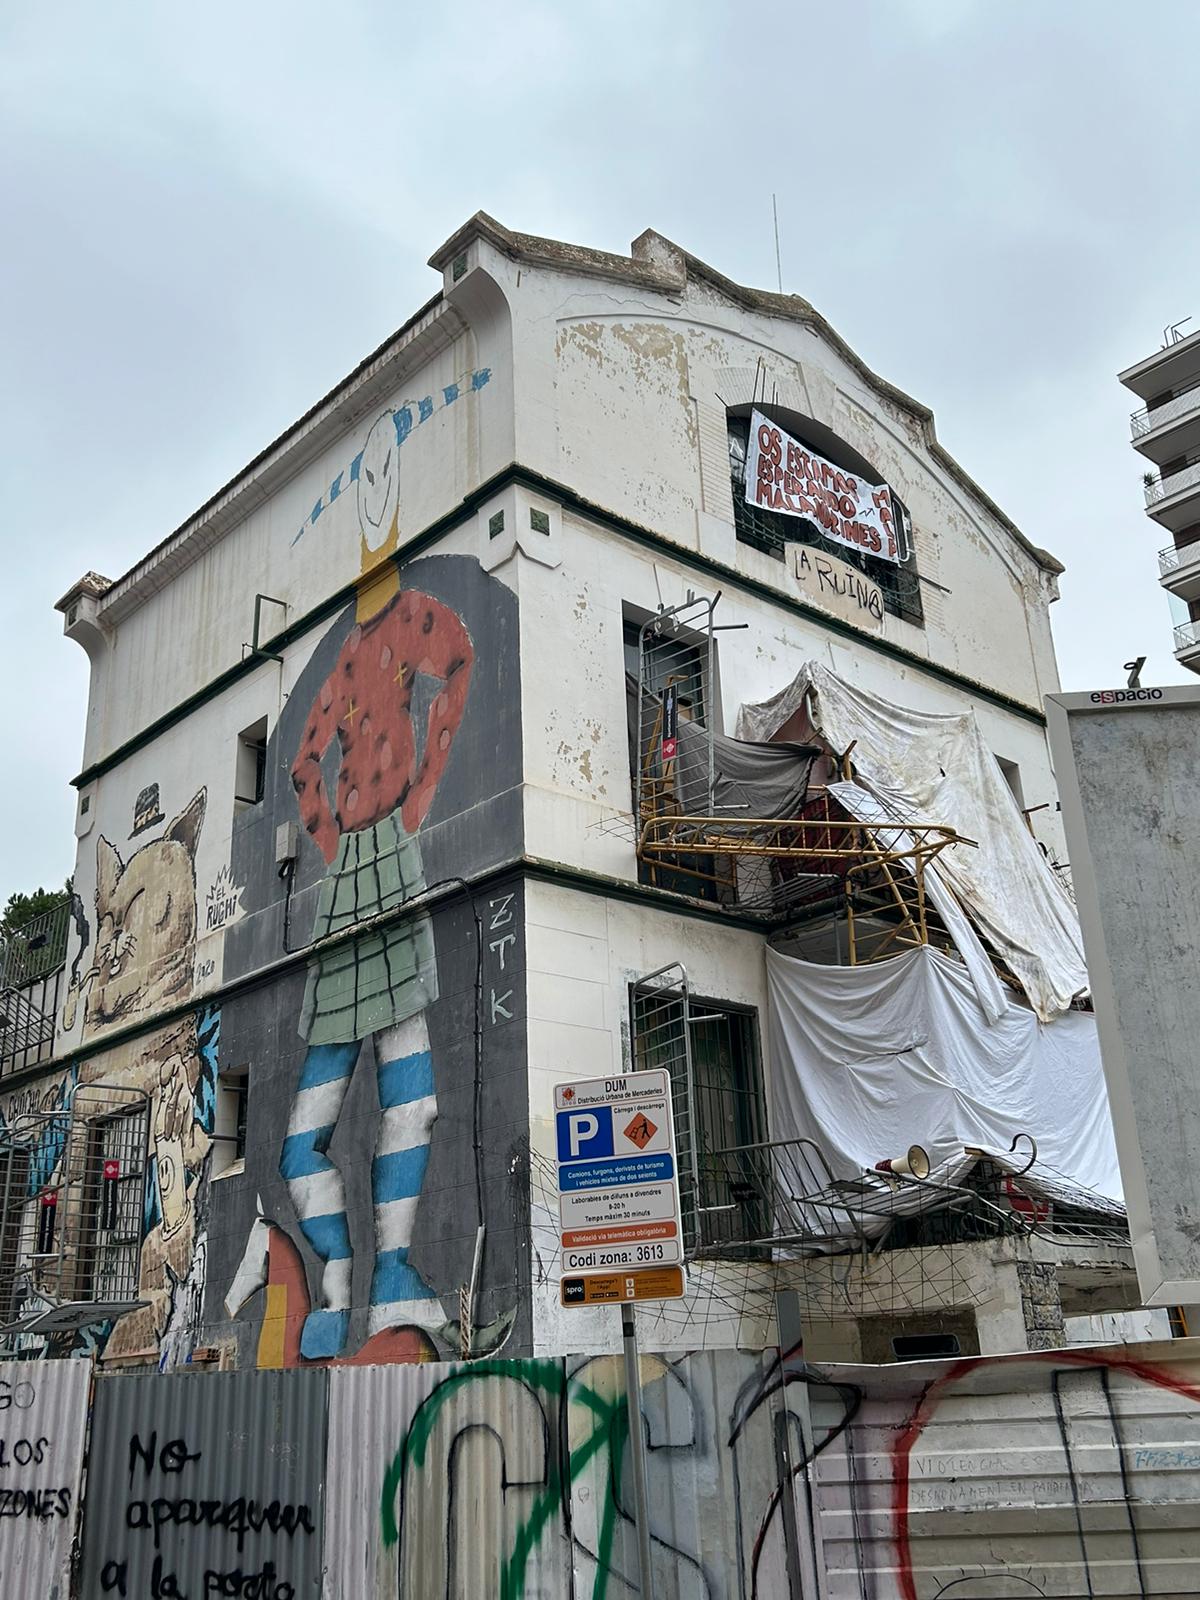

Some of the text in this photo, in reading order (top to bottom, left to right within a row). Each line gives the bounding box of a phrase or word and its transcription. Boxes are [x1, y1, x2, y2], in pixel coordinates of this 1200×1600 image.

[758, 424, 860, 503] OS ESTAMOS
[794, 549, 811, 580] LA
[1090, 688, 1163, 703] espacio
[216, 886, 226, 900] EL
[605, 1079, 627, 1093] DUM
[578, 1094, 605, 1105] Distribució
[606, 1092, 623, 1101] Urbana
[632, 1088, 663, 1097] Mercaderies
[569, 1113, 599, 1156] P
[644, 1161, 665, 1170] turismo
[571, 1195, 602, 1204] Laborables
[610, 1191, 629, 1200] dilluns
[634, 1189, 662, 1197] divendres
[585, 1214, 603, 1222] Temps
[632, 1209, 651, 1217] minuts
[572, 1233, 597, 1242] Validació
[607, 1230, 635, 1240] telemàtica
[636, 1227, 666, 1237] obligatòria
[569, 1244, 664, 1268] Codi zona: 3613
[0, 1437, 49, 1467] LOS
[101, 1560, 128, 1597] a
